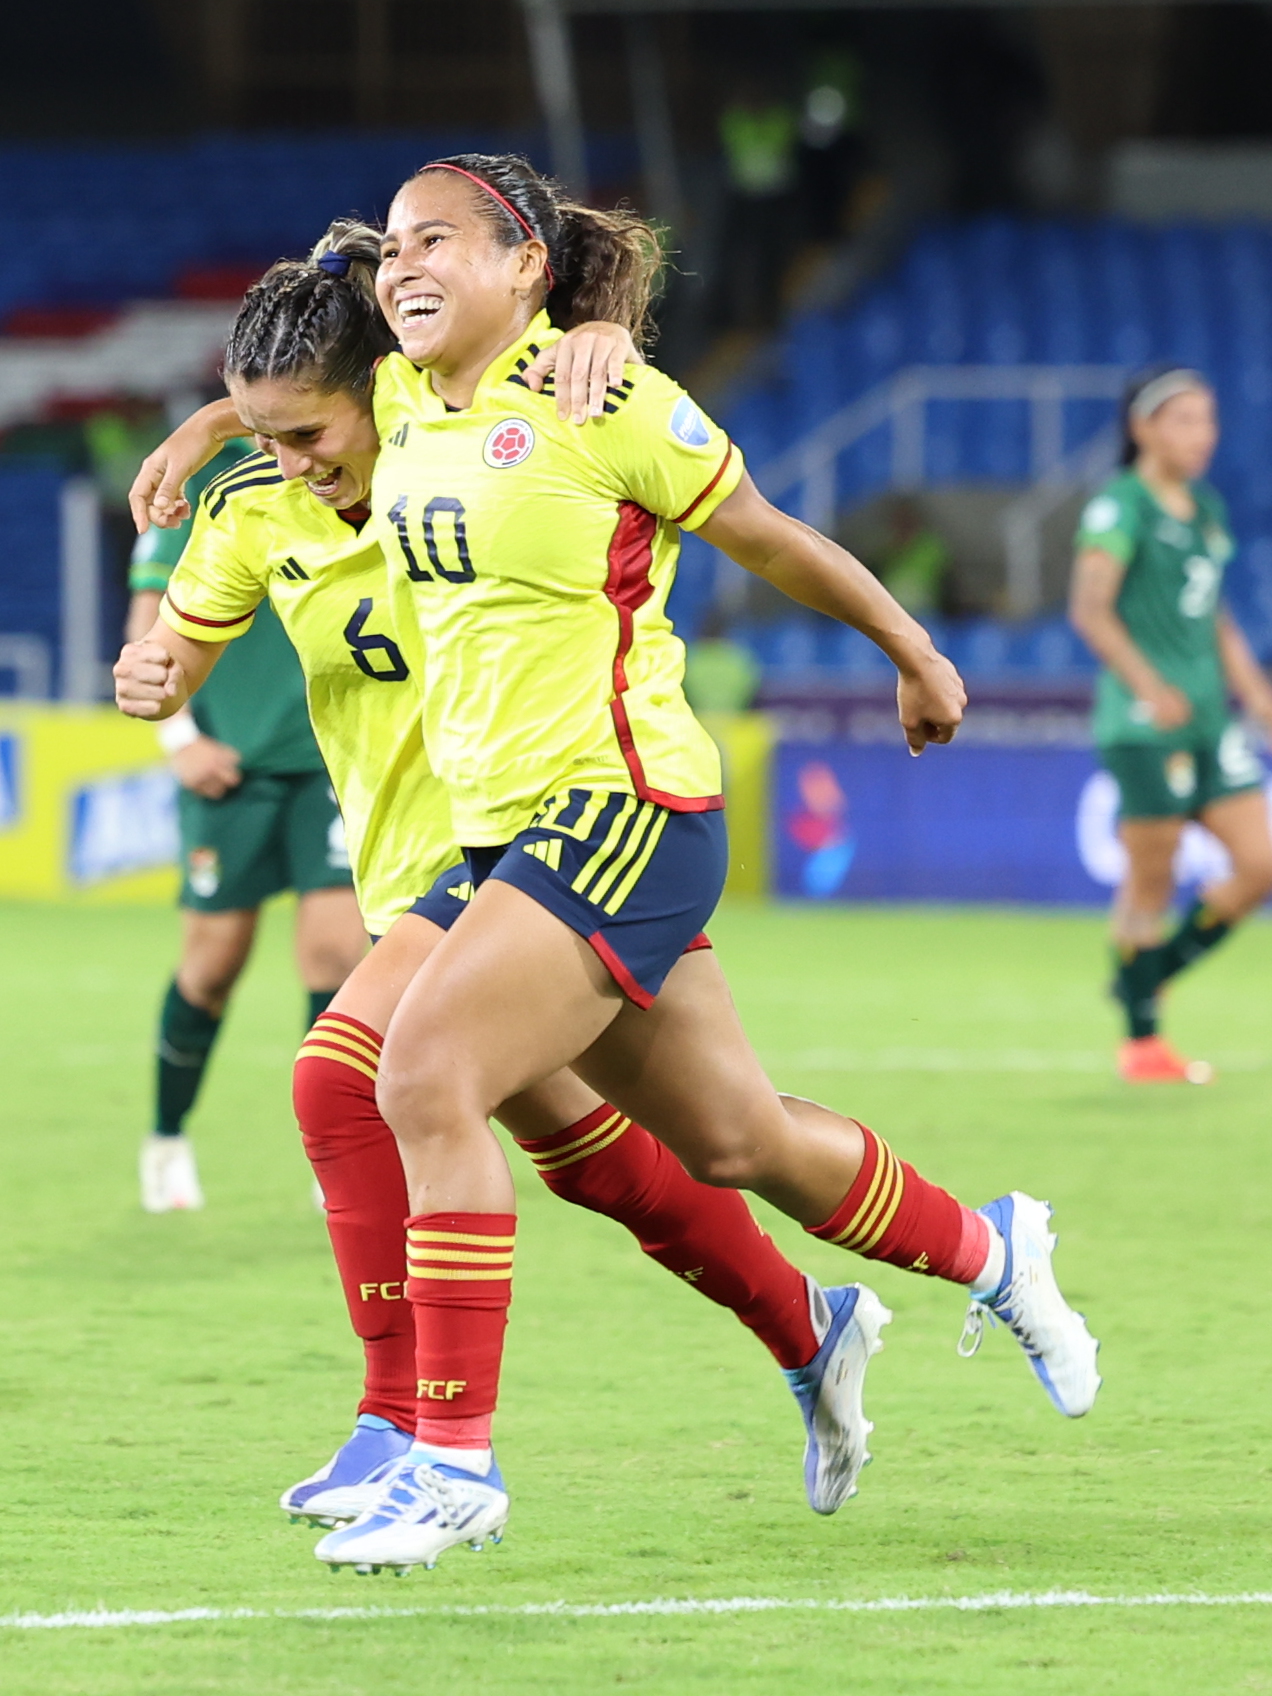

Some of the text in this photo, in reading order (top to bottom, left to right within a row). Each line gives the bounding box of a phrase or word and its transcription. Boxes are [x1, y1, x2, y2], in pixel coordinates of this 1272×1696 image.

[387, 494, 477, 584] 10
[343, 596, 410, 682] 6
[359, 1281, 409, 1302] FC
[416, 1378, 467, 1400] FCF
